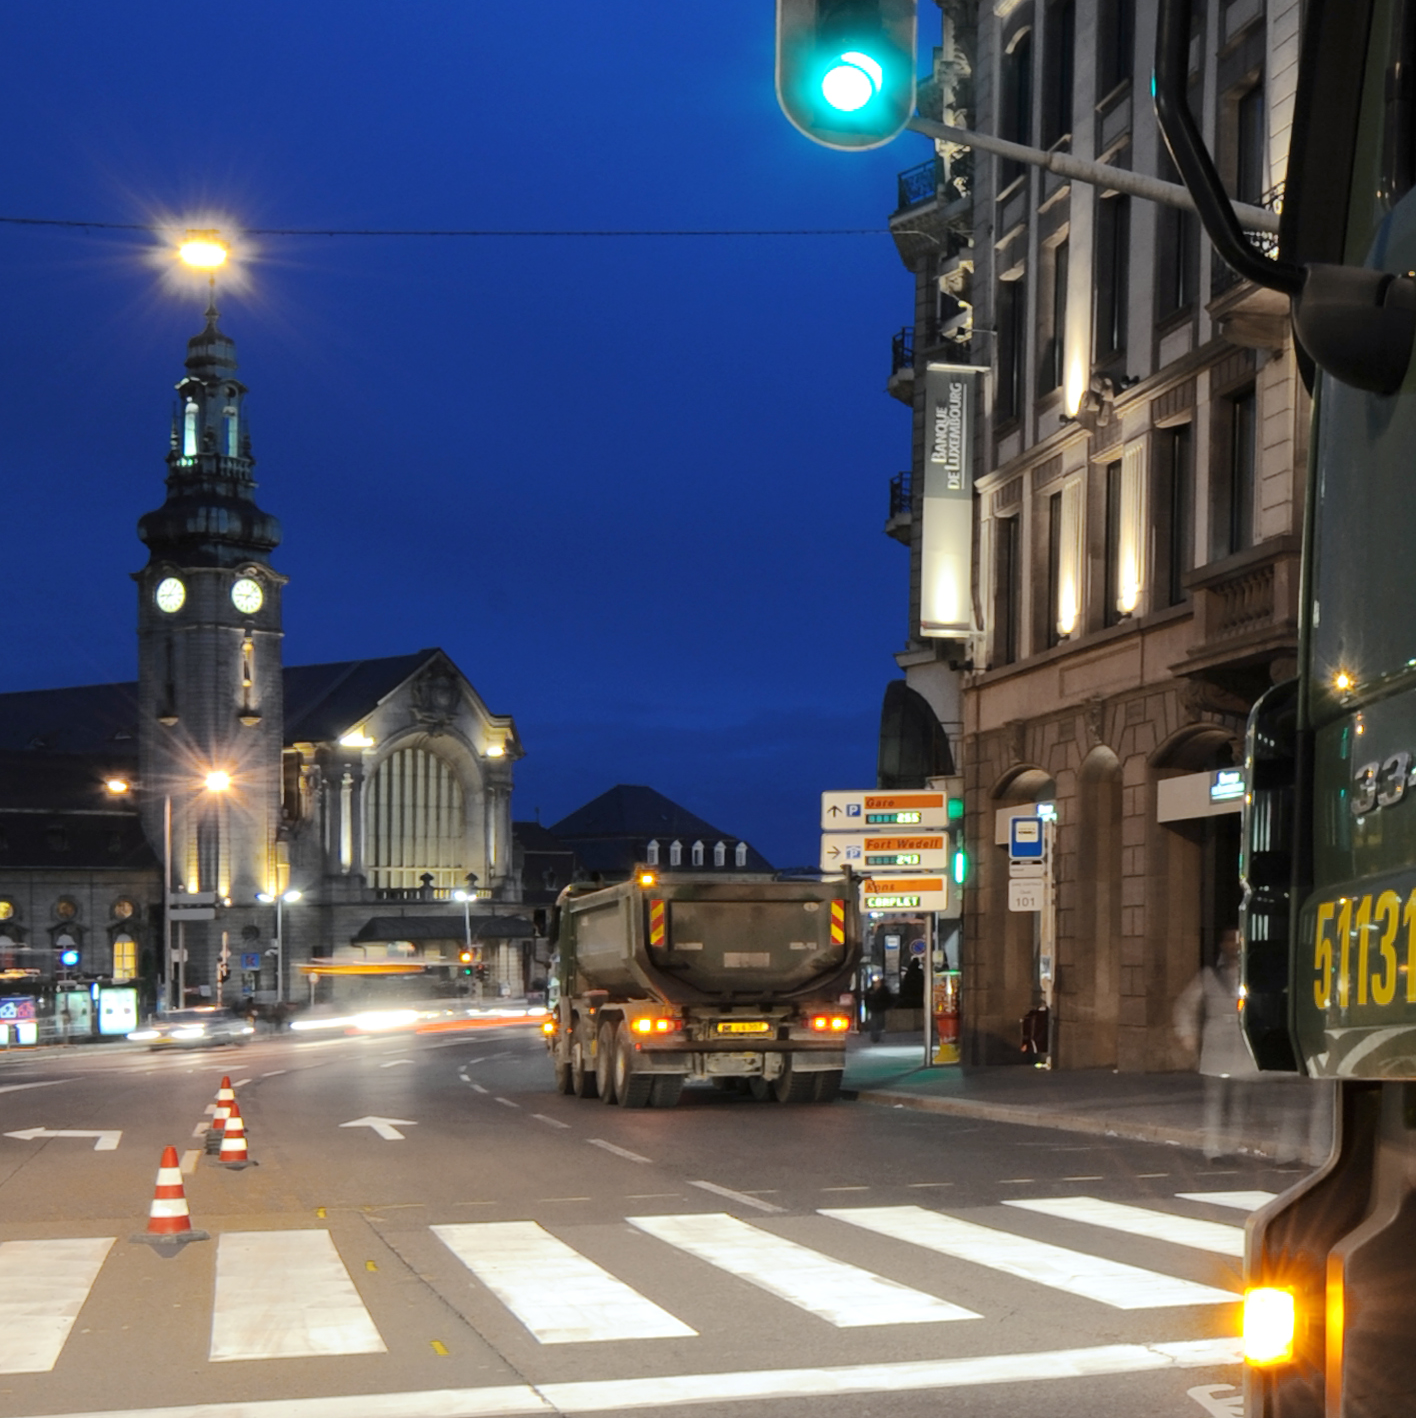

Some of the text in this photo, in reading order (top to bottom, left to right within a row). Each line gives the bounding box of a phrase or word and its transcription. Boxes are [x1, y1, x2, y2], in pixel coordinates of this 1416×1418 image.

[944, 382, 963, 470] LUXEMBOURG
[931, 407, 949, 463] BANQUE
[865, 797, 895, 808] Gare
[865, 839, 892, 850] Fort
[896, 837, 938, 849] Wedell
[867, 896, 918, 908] COMPLET
[1016, 897, 1035, 907] 101
